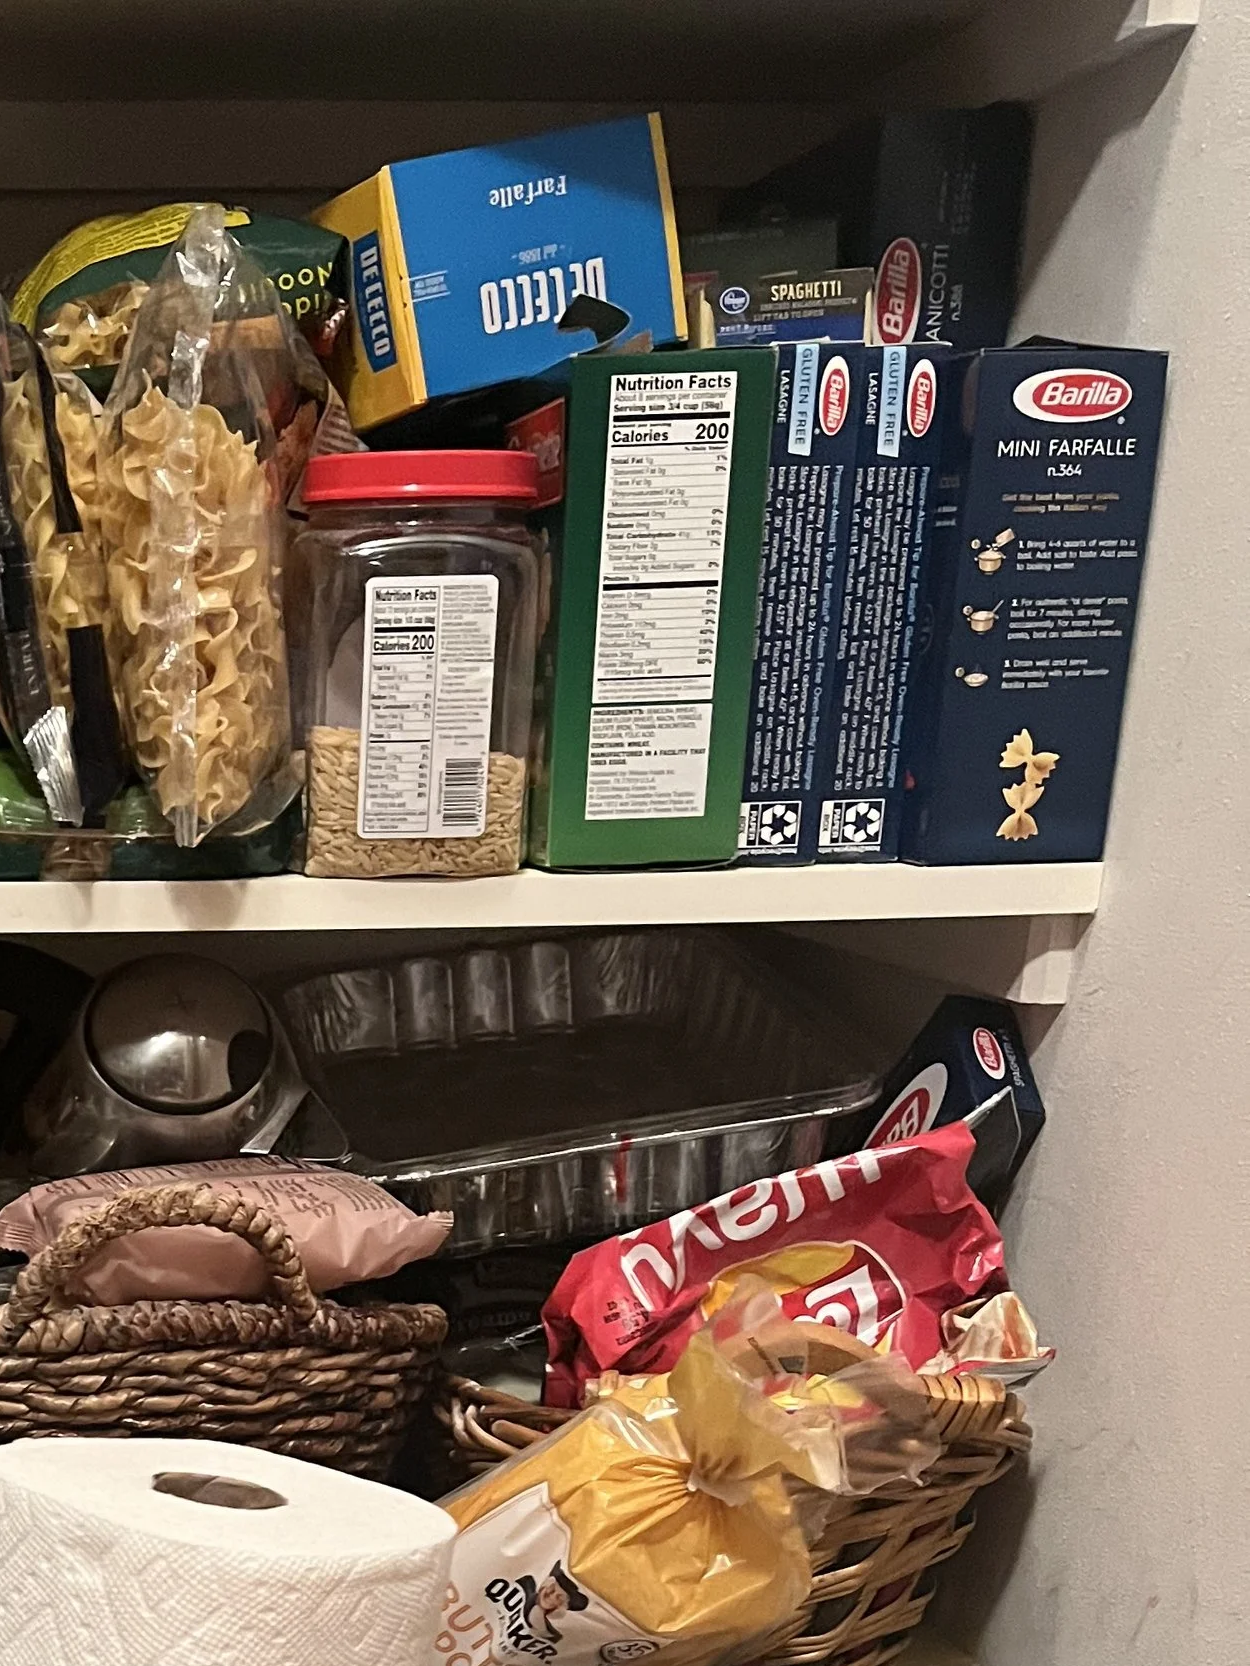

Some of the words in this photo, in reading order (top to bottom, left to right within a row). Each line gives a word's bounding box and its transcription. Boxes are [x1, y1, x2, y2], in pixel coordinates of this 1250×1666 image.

[488, 174, 568, 209] Farfalle
[770, 280, 843, 301] SPAGHETTI
[882, 249, 911, 338] Barilla
[924, 244, 950, 342] ANICOTTI
[615, 376, 684, 392] Nutrition
[688, 374, 732, 389] Facts
[799, 348, 813, 404] GLUTEN
[887, 352, 900, 407] GLUTEN
[613, 403, 647, 413] Serving
[648, 403, 666, 411] size
[682, 402, 699, 412] cup
[777, 370, 791, 424] LASAGNE
[826, 375, 844, 428] Barilla
[865, 373, 878, 425] LASAGNE
[912, 377, 931, 430] Barilla
[1039, 378, 1124, 409] Barilla
[611, 429, 669, 443] Calories
[695, 422, 730, 440] 200
[795, 411, 809, 445] FREE
[884, 413, 897, 447] FREE
[997, 439, 1040, 458] MINI
[1048, 438, 1137, 458] FARFALLE
[375, 588, 412, 601] Nutrition
[414, 588, 437, 601] Facts
[373, 640, 411, 651] Calories
[411, 634, 435, 651] 200
[748, 810, 757, 840] PAPER
[832, 808, 841, 838] PAPER
